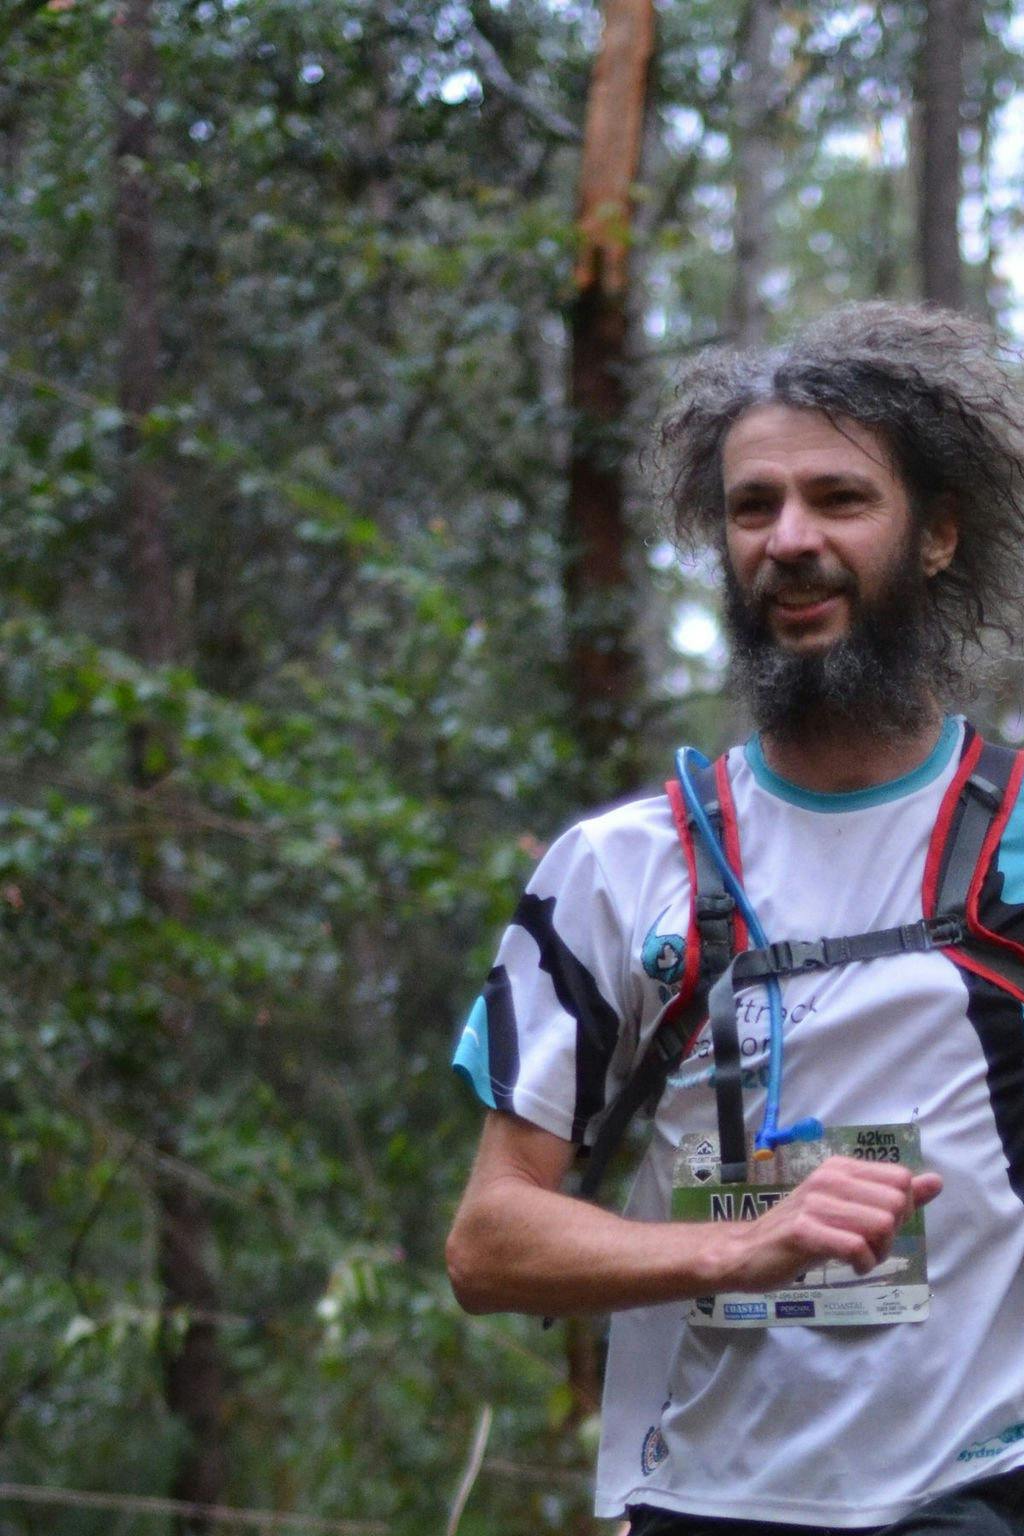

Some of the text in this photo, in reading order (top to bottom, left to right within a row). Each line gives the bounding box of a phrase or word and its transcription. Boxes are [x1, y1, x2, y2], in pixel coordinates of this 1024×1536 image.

[856, 1131, 896, 1146] 42km
[853, 1146, 900, 1163] 2023
[710, 1193, 791, 1222] NAT
